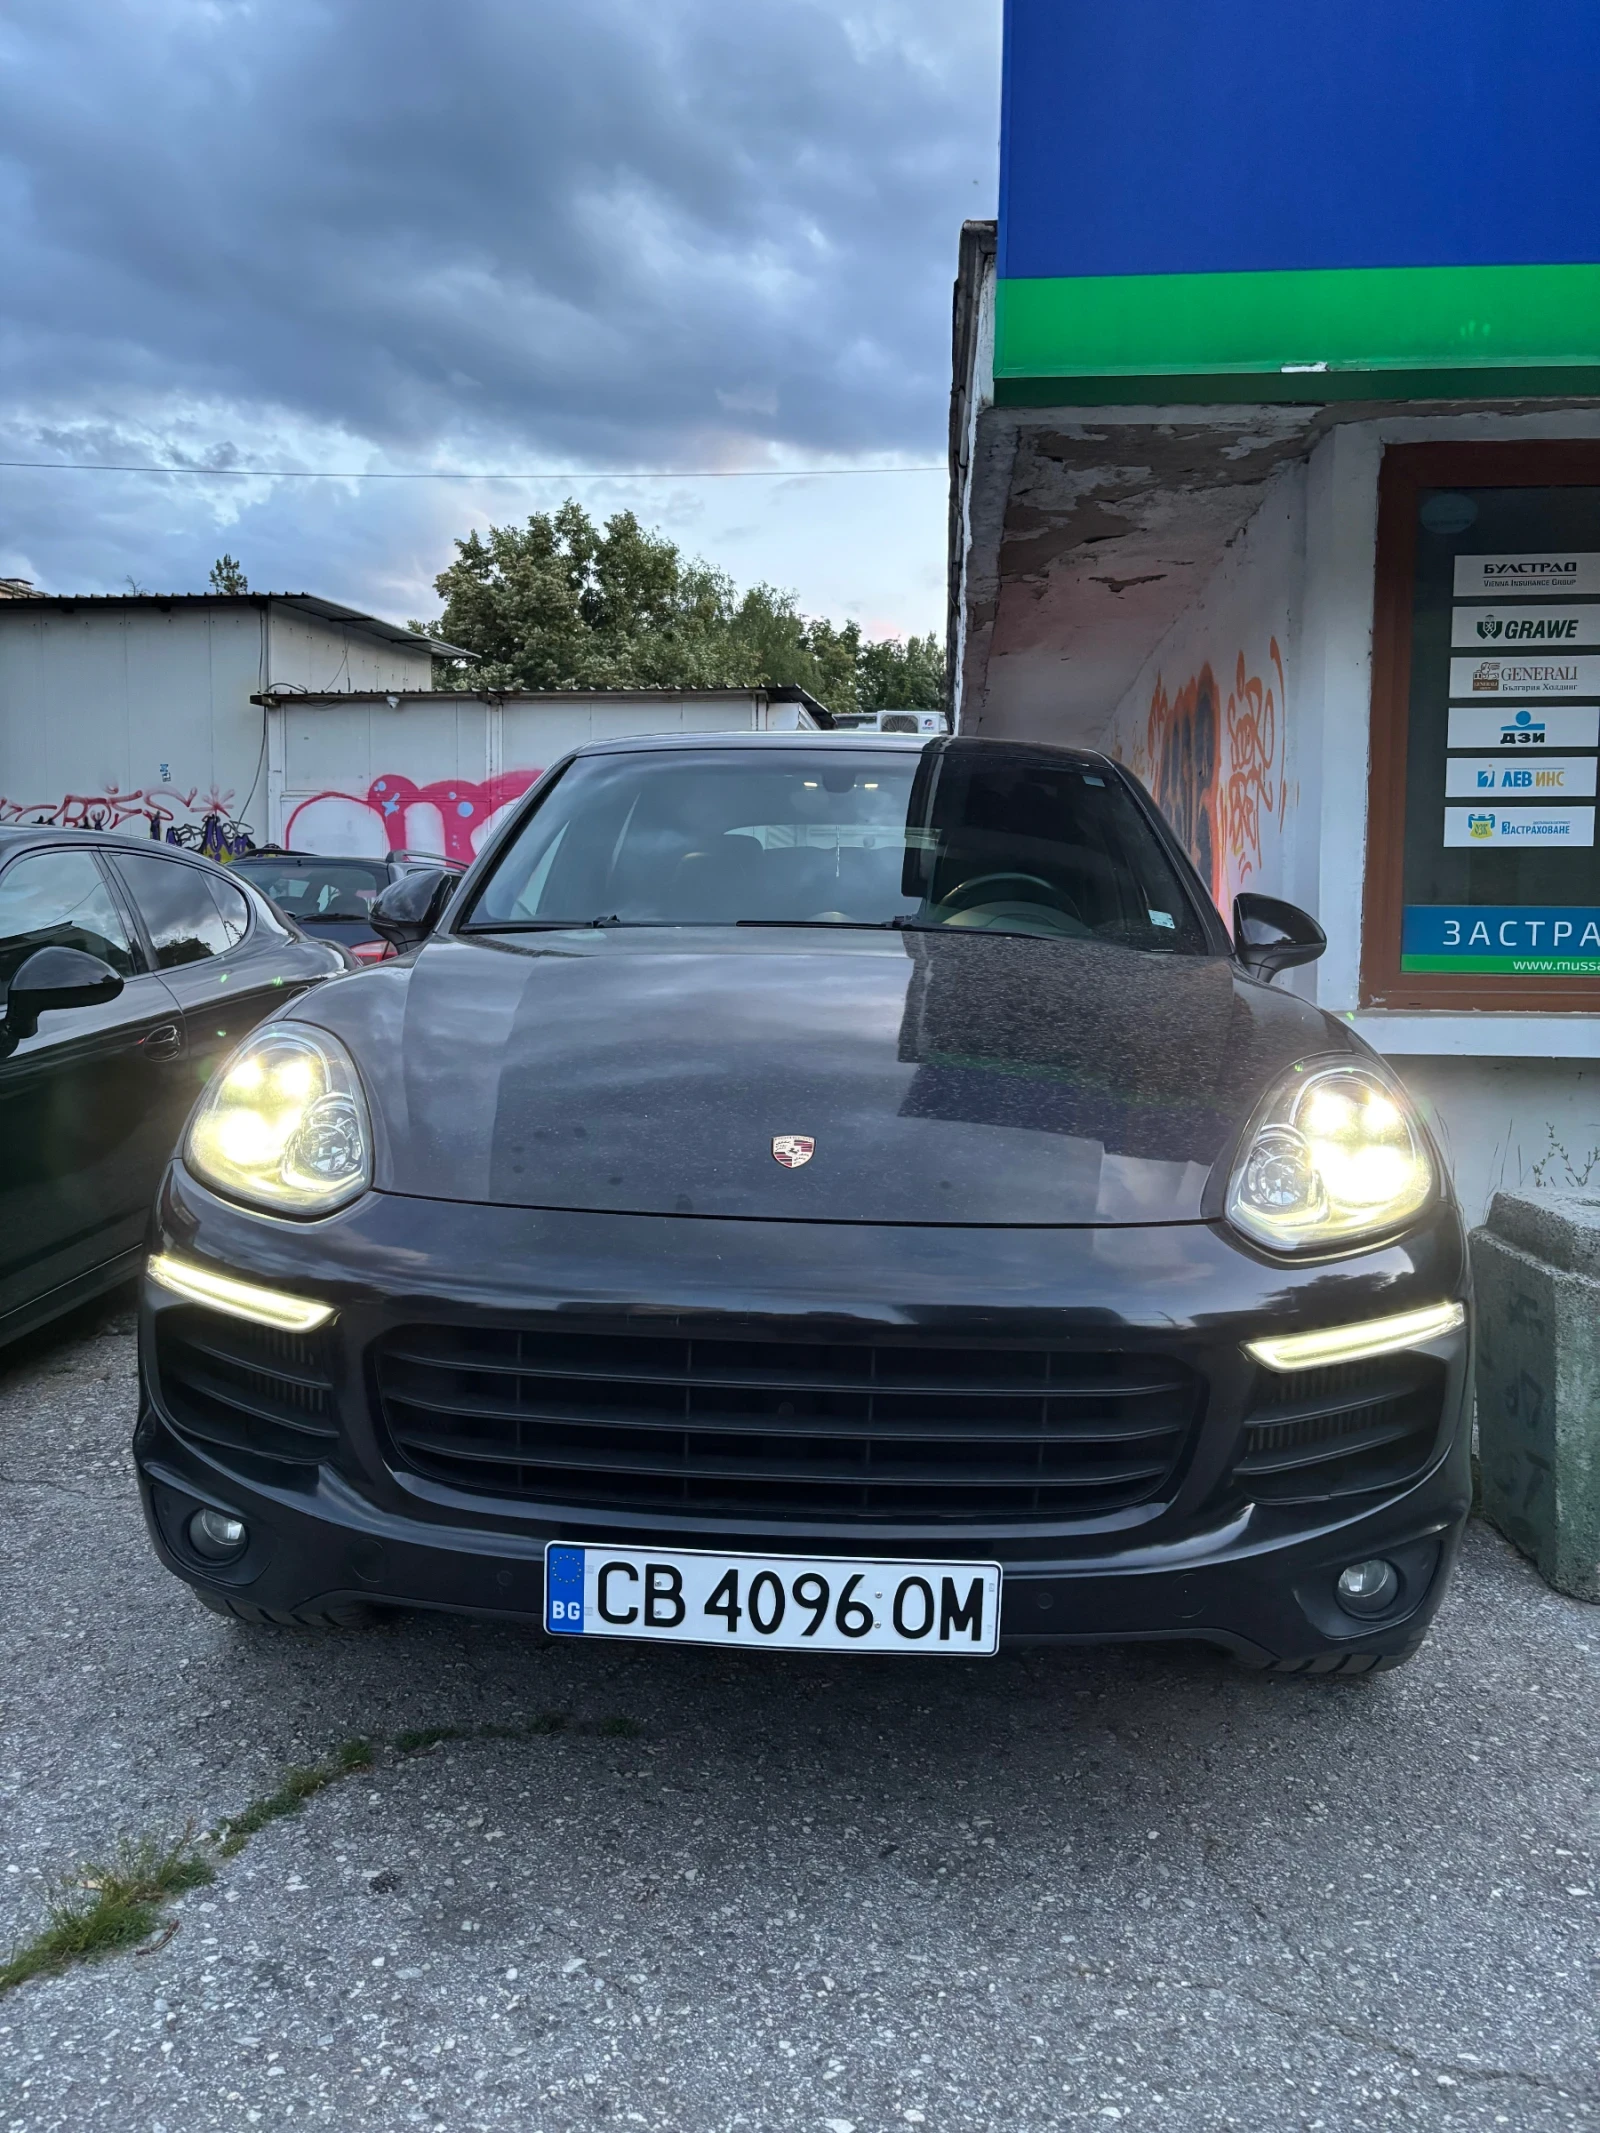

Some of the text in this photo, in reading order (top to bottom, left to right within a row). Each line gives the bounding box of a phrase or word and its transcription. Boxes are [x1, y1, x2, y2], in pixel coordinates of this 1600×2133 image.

[1484, 562, 1577, 574] БУЛСТРАД
[1505, 619, 1579, 640] GRAWE
[1501, 666, 1578, 681] GENERALI
[1502, 683, 1540, 692] България
[1542, 683, 1578, 692] Холдинг
[1500, 732, 1545, 744] ДЗИ
[1501, 771, 1565, 788] ЛЕВ ИНС
[1501, 821, 1571, 835] ЗАСТРАХОВАНЕ
[1442, 920, 1600, 947] ЗАСТРА
[597, 1562, 985, 1642] CB 4096 OM
[552, 1600, 581, 1621] BG
